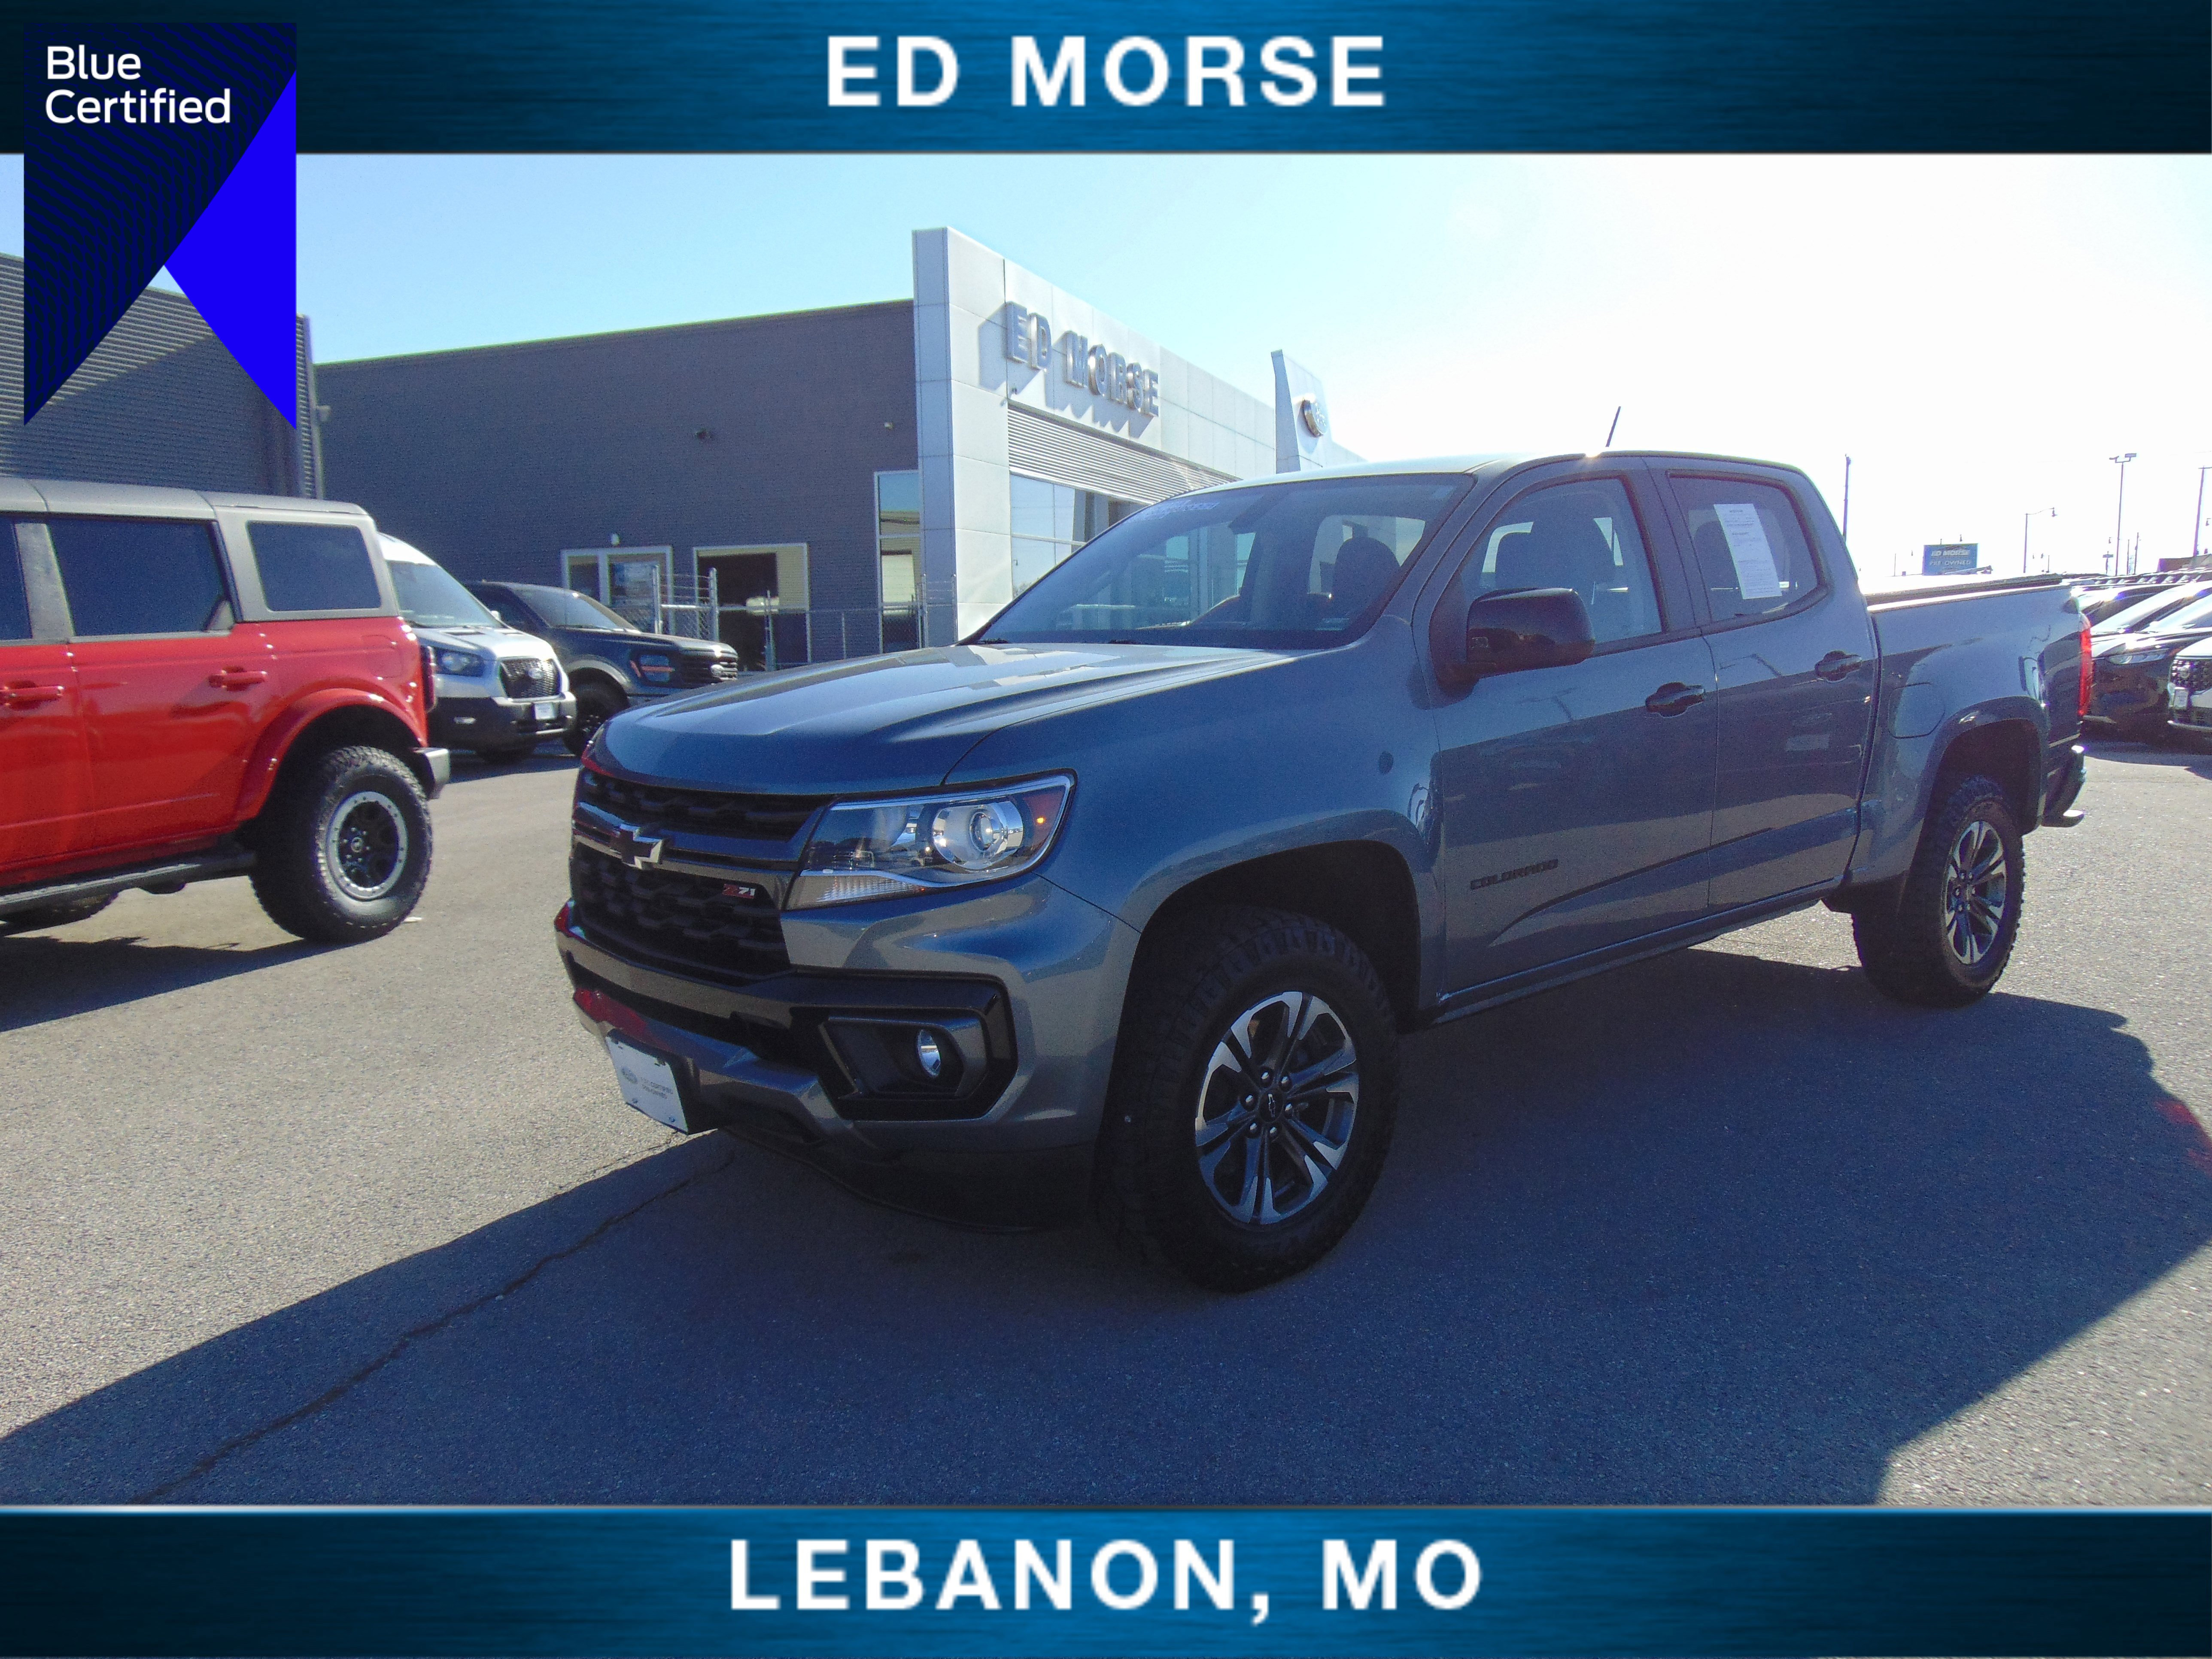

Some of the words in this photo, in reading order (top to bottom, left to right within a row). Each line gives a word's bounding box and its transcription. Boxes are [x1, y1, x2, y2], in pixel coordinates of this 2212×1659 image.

[1006, 301, 1051, 370] ED
[1066, 330, 1159, 417] MORSE
[1470, 859, 1559, 890] COLORADO
